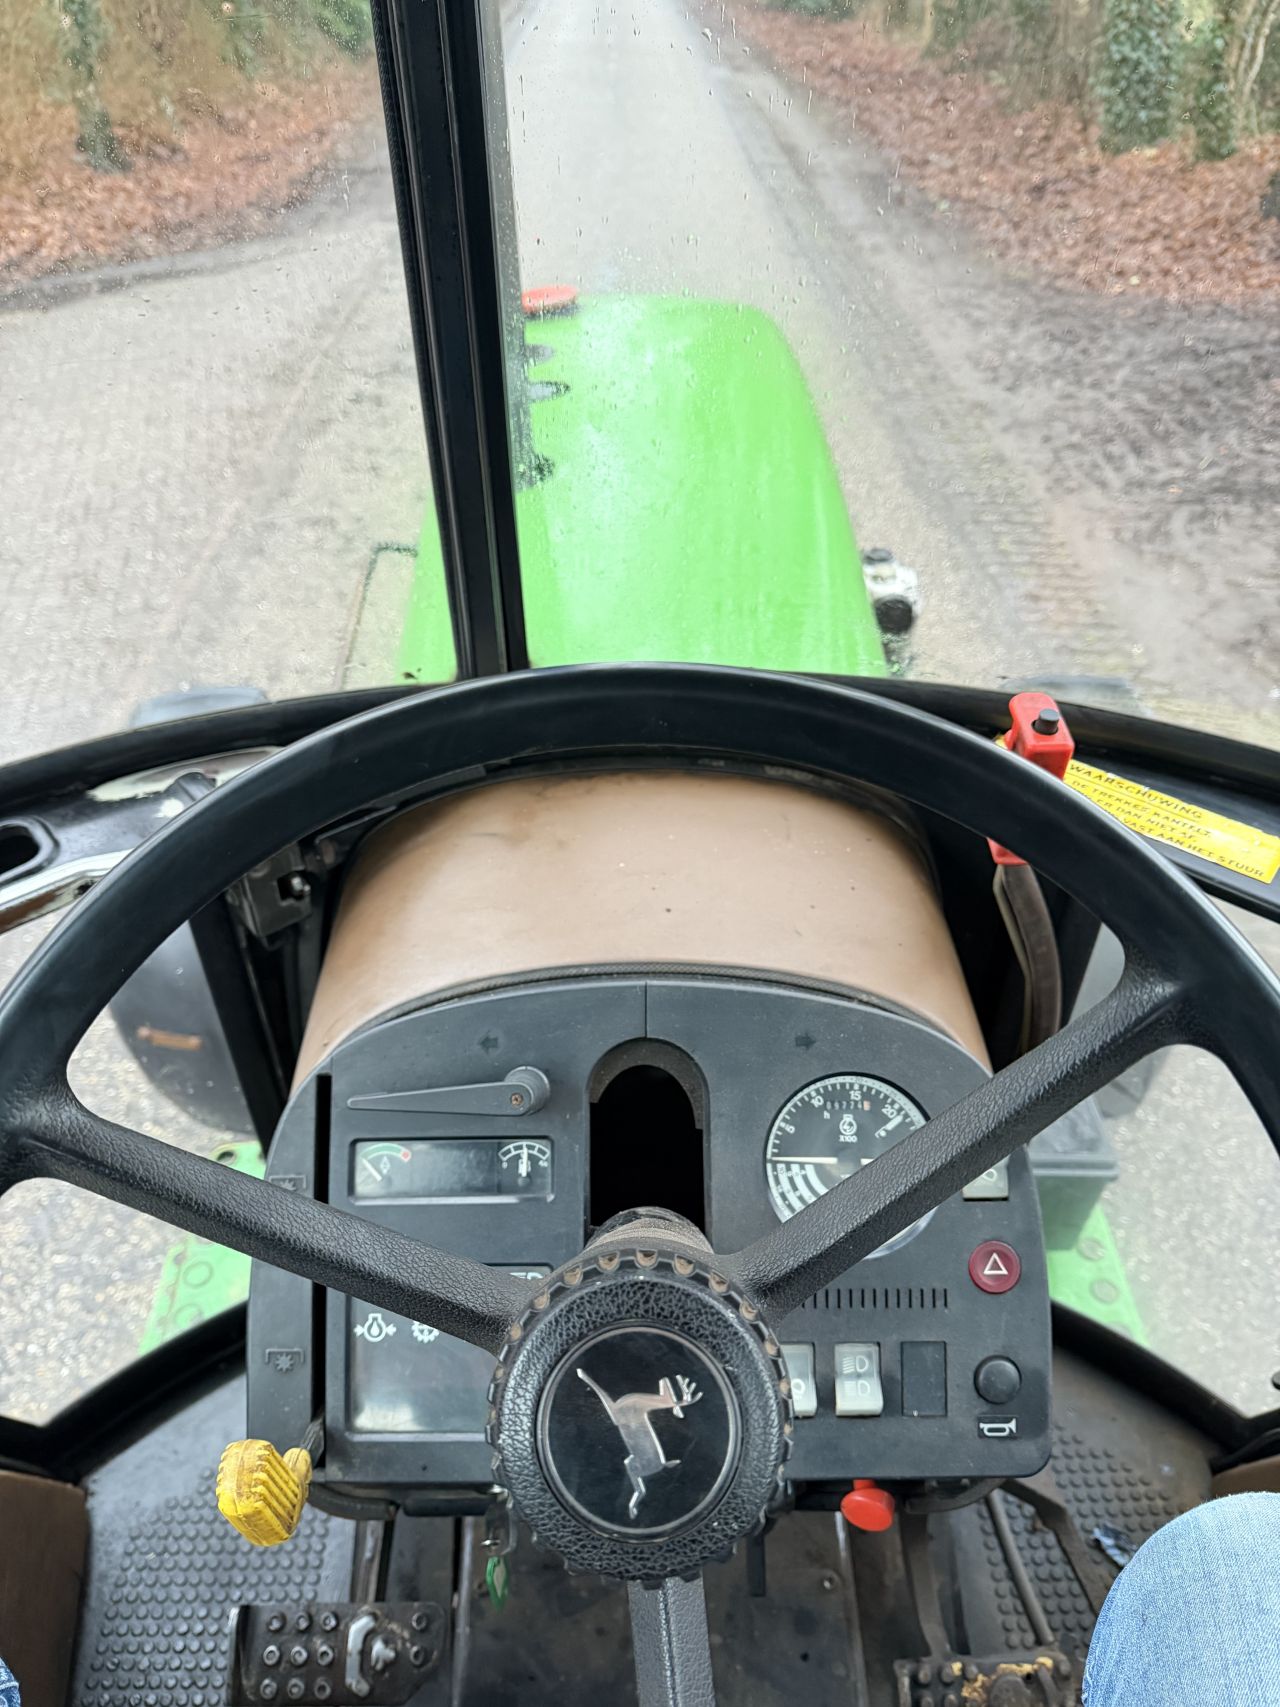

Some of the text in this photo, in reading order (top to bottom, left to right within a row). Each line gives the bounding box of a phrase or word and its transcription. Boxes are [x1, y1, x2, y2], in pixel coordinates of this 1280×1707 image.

[1070, 763, 1202, 819] WAARSCHUWING
[1116, 806, 1142, 820] DAN
[1147, 818, 1177, 833] NIET
[1123, 817, 1265, 877] VAST AAN HET STUUR
[810, 1095, 825, 1108] 10
[848, 1090, 863, 1102] 15
[881, 1103, 897, 1119] 20
